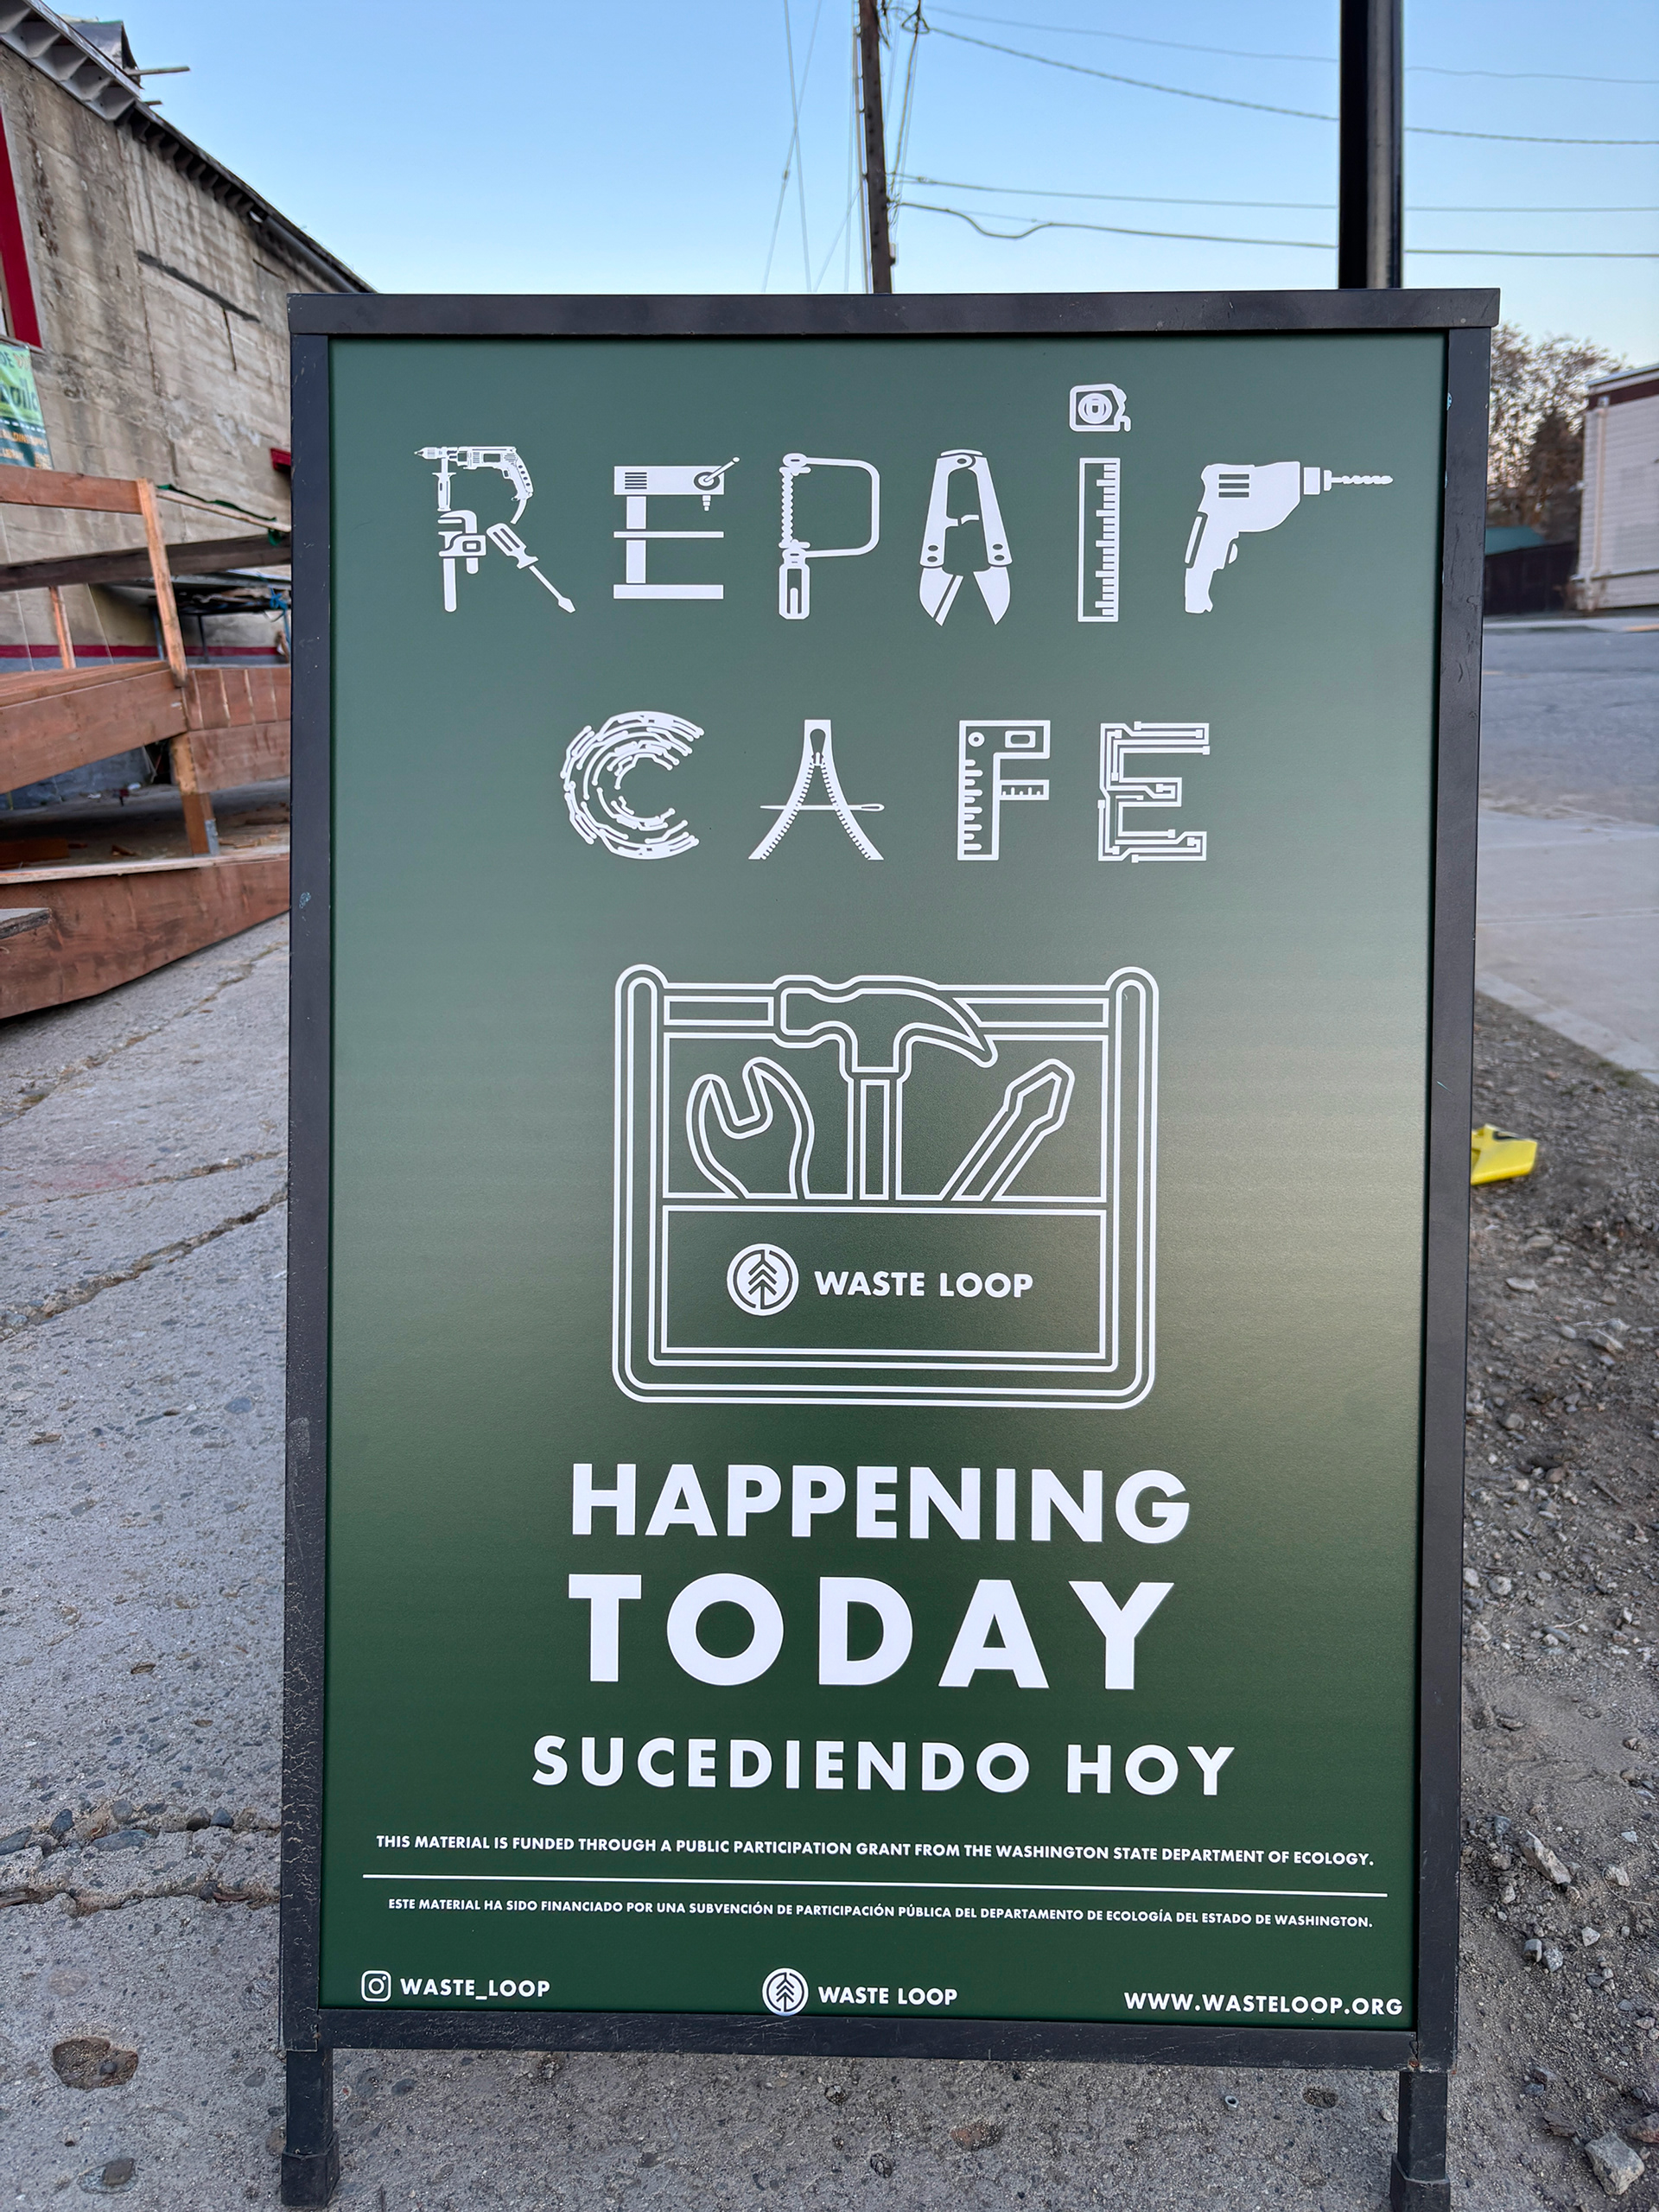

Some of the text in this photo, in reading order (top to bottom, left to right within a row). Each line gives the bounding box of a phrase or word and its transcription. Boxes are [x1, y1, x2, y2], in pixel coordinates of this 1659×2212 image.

[559, 710, 1211, 864] CAFE
[814, 1270, 1033, 1299] WASTE LOOP
[572, 1463, 1191, 1544] HAPPENING
[568, 1573, 1175, 1690] TODAY
[532, 1735, 1235, 1796] SUCEDIENDO HOY
[376, 1835, 1374, 1866] THIS MATERIAL IS FUNDED THROUGH A PUBLIC PARTICIPATION GRANT FROM THE WASHINGTON STATE DEPARTMENT OF ECOLOGY.
[388, 1898, 1373, 1928] ESTE MATERIAL HA SIDO FINANCIADO POR UNA SUBVENCIÓN DE PARTICIPACIÓN PÚBLICA DEL DEPARTAMENTO DE ECOLOGÍA DEL ESTADO DE WASHINGTON.
[399, 1978, 550, 2000] WASTE_LOOP
[817, 1986, 957, 2005] WASTE LOOP
[1123, 1992, 1403, 2015] WWW.WASTELOOP.ORG
